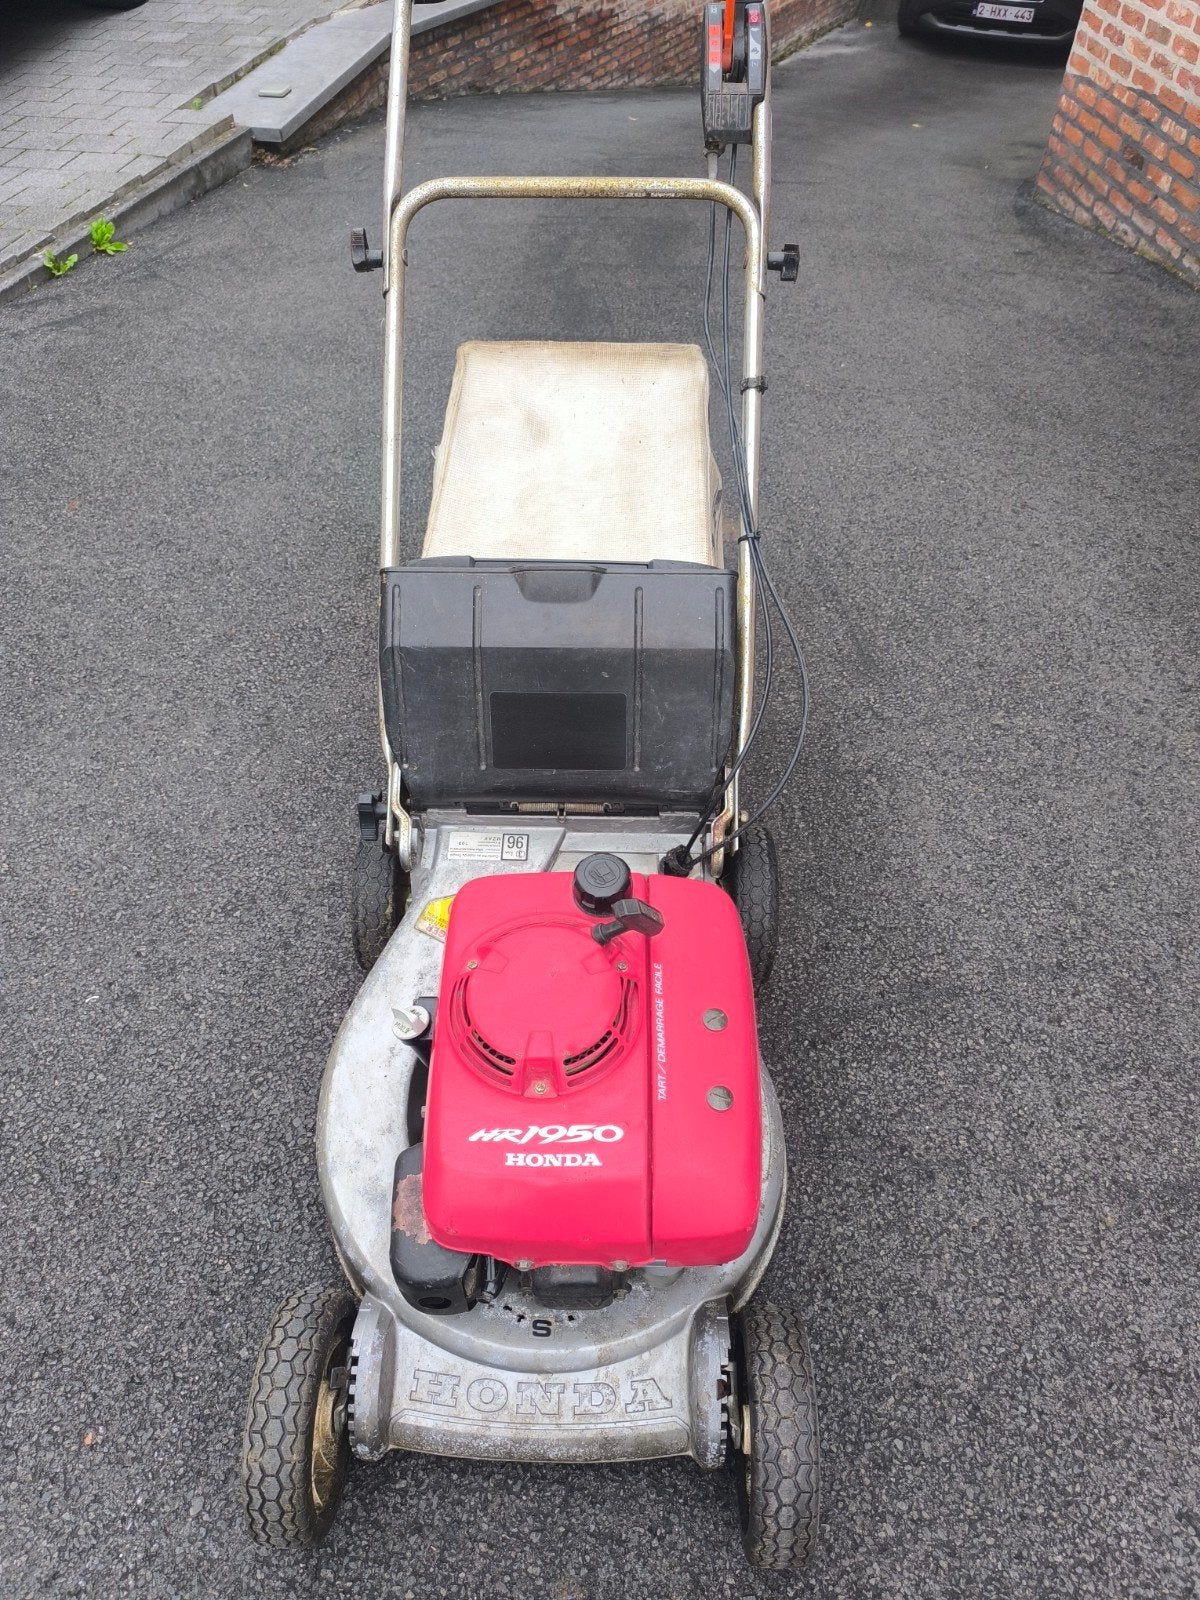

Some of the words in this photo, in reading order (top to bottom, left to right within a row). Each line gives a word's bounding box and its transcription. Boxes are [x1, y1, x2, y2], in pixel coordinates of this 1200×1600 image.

[978, 5, 1033, 20] 2-HXX-443
[506, 835, 525, 849] 96
[654, 963, 664, 995] FACILE
[504, 1152, 603, 1168] HONDA
[532, 1319, 552, 1338] S
[409, 1369, 673, 1416] HONDA
